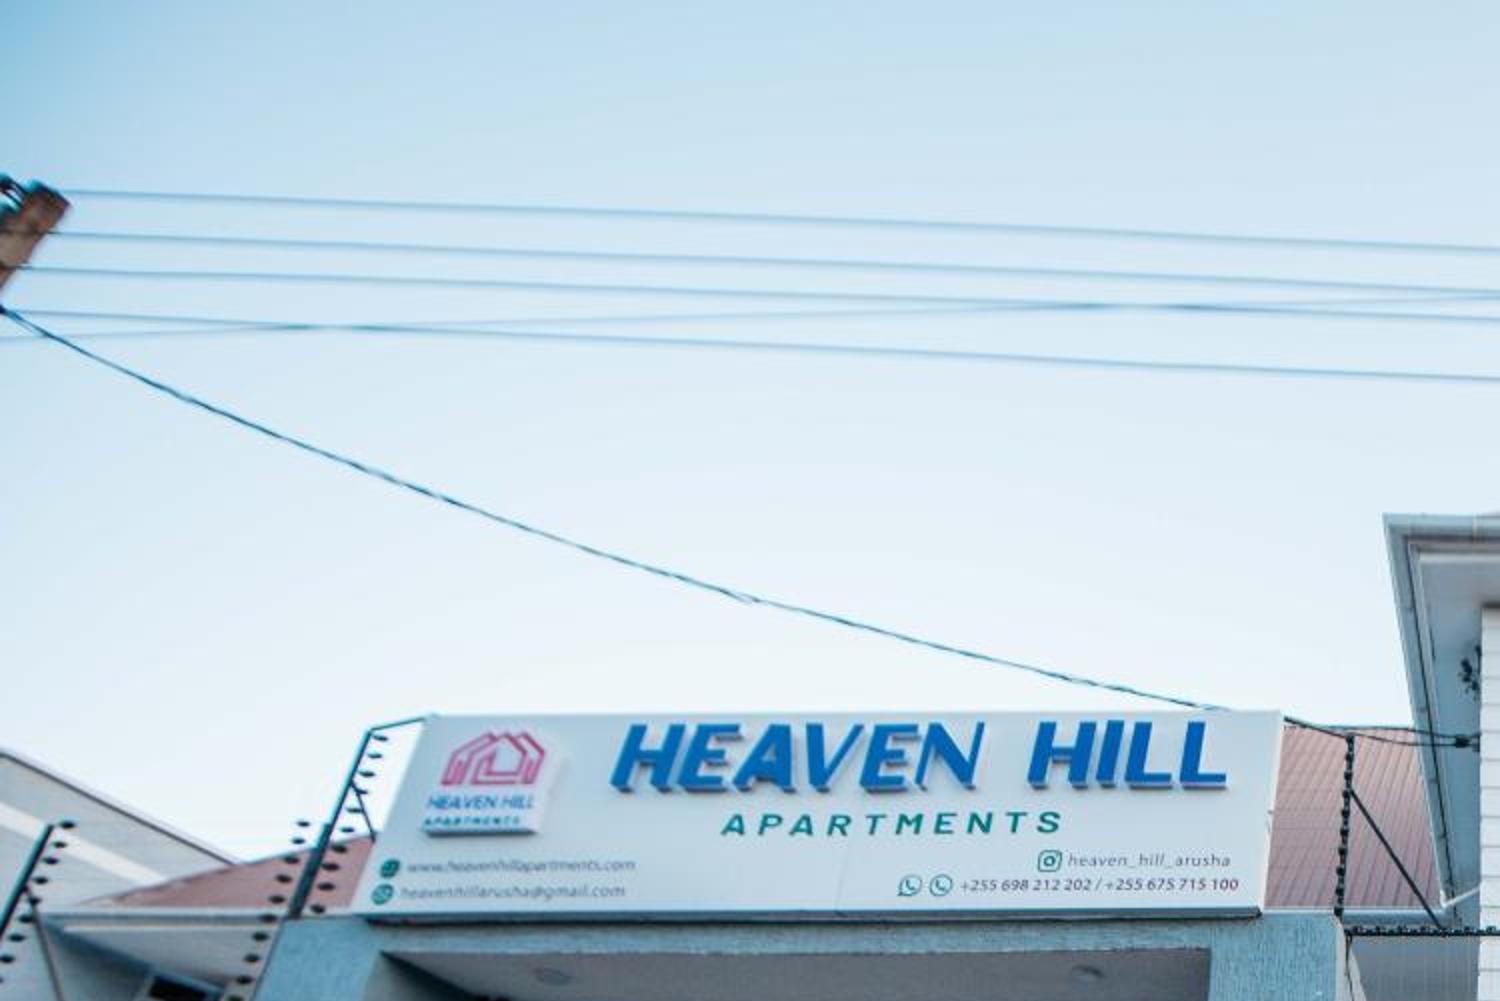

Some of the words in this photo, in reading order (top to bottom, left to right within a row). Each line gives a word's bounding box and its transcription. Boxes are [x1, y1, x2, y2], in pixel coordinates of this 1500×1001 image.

[611, 722, 986, 793] HEAVEN
[1027, 720, 1227, 790] HILL
[426, 794, 497, 810] HEAVEN
[501, 794, 534, 810] HILL
[424, 815, 521, 826] APARTMENTS
[720, 811, 1062, 837] APARTMENTS
[1067, 853, 1231, 869] heaven_hill_arusha
[402, 884, 627, 900] heavenhillarusha@gmail.com
[960, 879, 998, 892] +255
[1001, 879, 1030, 892] 698
[1032, 879, 1060, 892] 212
[1063, 878, 1091, 892] 202
[1146, 878, 1175, 892] 675
[1179, 878, 1207, 892] 715
[1210, 878, 1239, 892] 100
